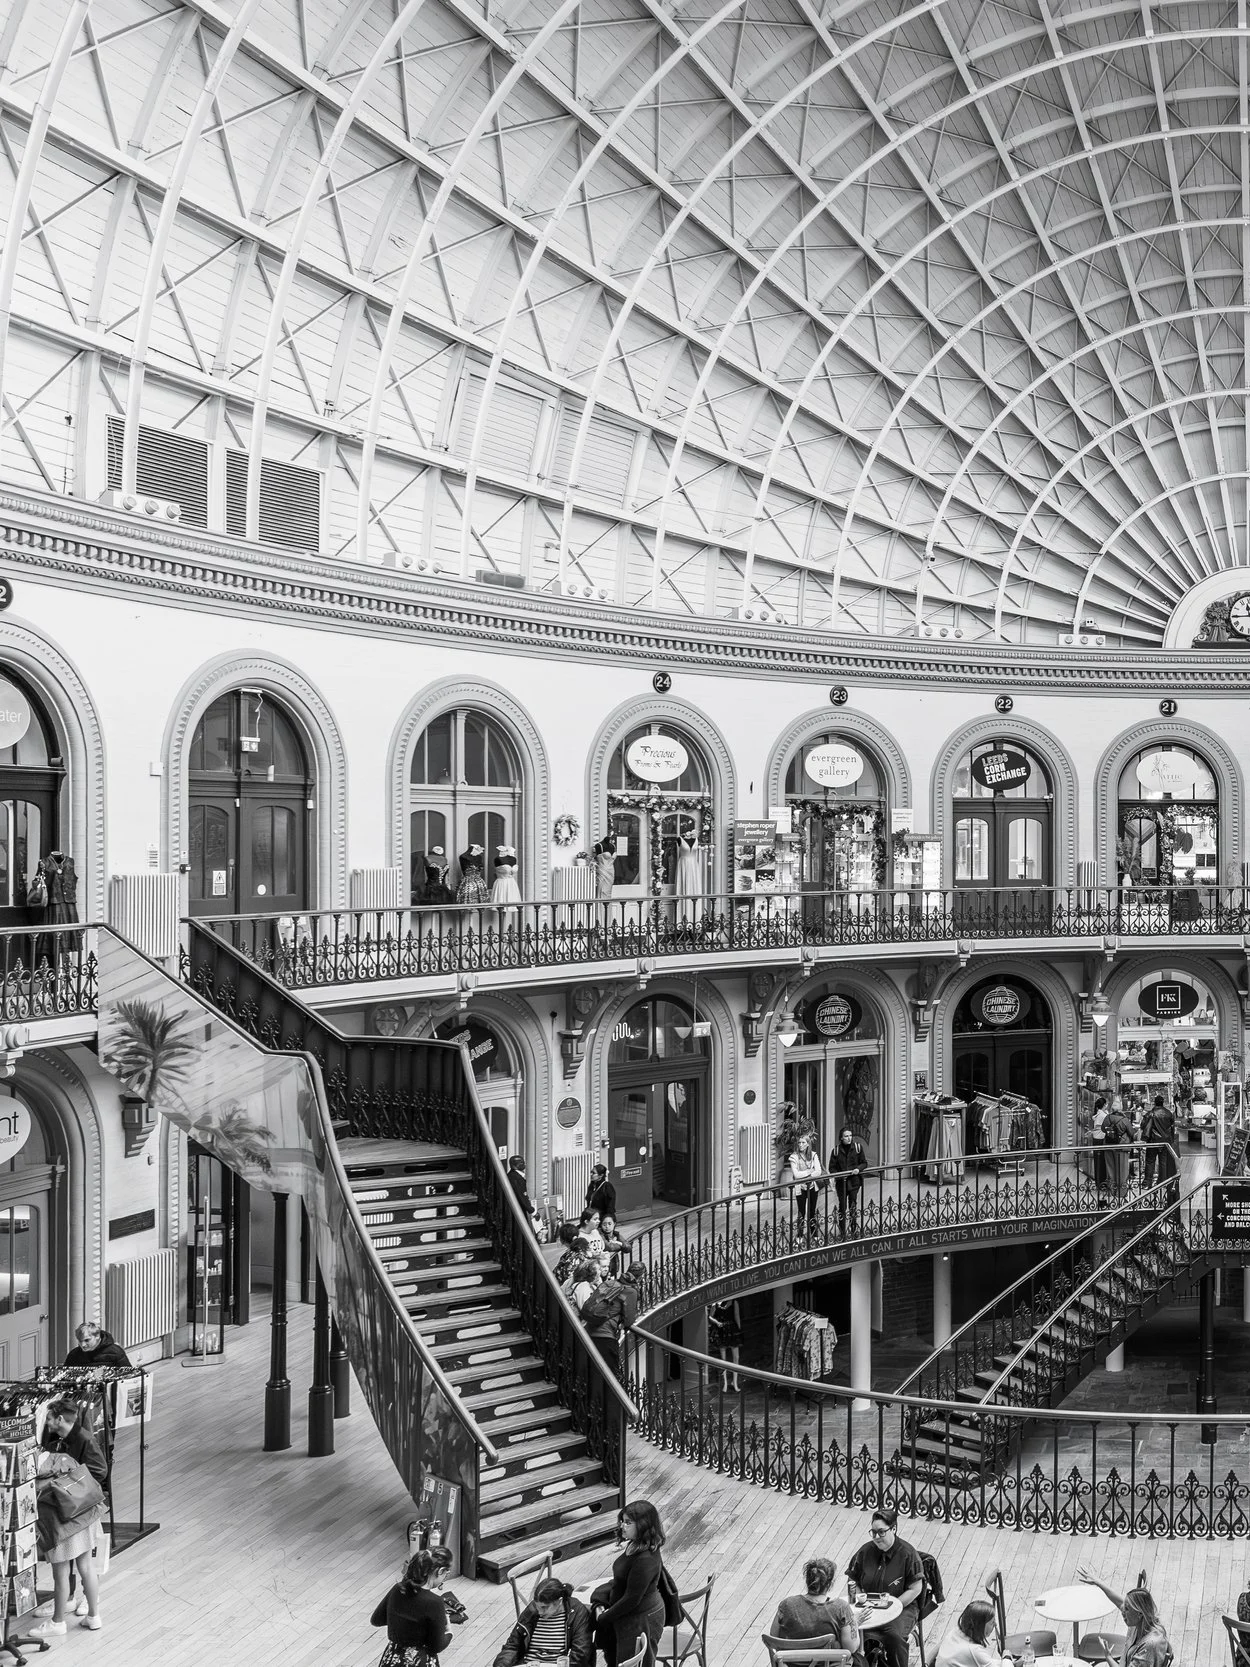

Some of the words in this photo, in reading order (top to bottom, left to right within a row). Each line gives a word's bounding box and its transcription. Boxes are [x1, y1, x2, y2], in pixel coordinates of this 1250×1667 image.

[0, 585, 7, 602] 2
[656, 676, 670, 688] 24
[832, 690, 847, 701] 23
[997, 699, 1012, 709] 22
[1161, 702, 1175, 713] 21
[640, 745, 677, 758] Precious
[811, 753, 857, 765] evergreen
[981, 752, 1009, 767] LEEDS
[818, 765, 850, 779] gallery
[984, 762, 1006, 775] CORN
[985, 766, 1027, 784] EXCHANGE
[743, 829, 769, 837] jewellery
[986, 996, 1016, 1006] CHINESE
[819, 1006, 848, 1016] CHINESE
[986, 1004, 1016, 1013] LAUNDRY
[819, 1014, 847, 1024] LAUNDRY
[469, 1038, 494, 1061] ANGE
[706, 1282, 728, 1299] WANT
[741, 1271, 760, 1287] LIVE
[764, 1265, 781, 1279] YOU
[783, 1260, 801, 1274] CAN
[810, 1253, 829, 1267] CAN
[832, 1249, 847, 1262] WE
[850, 1245, 868, 1258] ALL
[896, 1238, 906, 1249] IT
[908, 1234, 928, 1247] ALL
[931, 1229, 969, 1244] STARTS
[971, 1225, 998, 1239] WITH
[1001, 1221, 1028, 1235] YOUR
[1032, 1217, 1097, 1233] IMAGINATION
[0, 1418, 25, 1429] ELCOME
[19, 1423, 32, 1431] FUN
